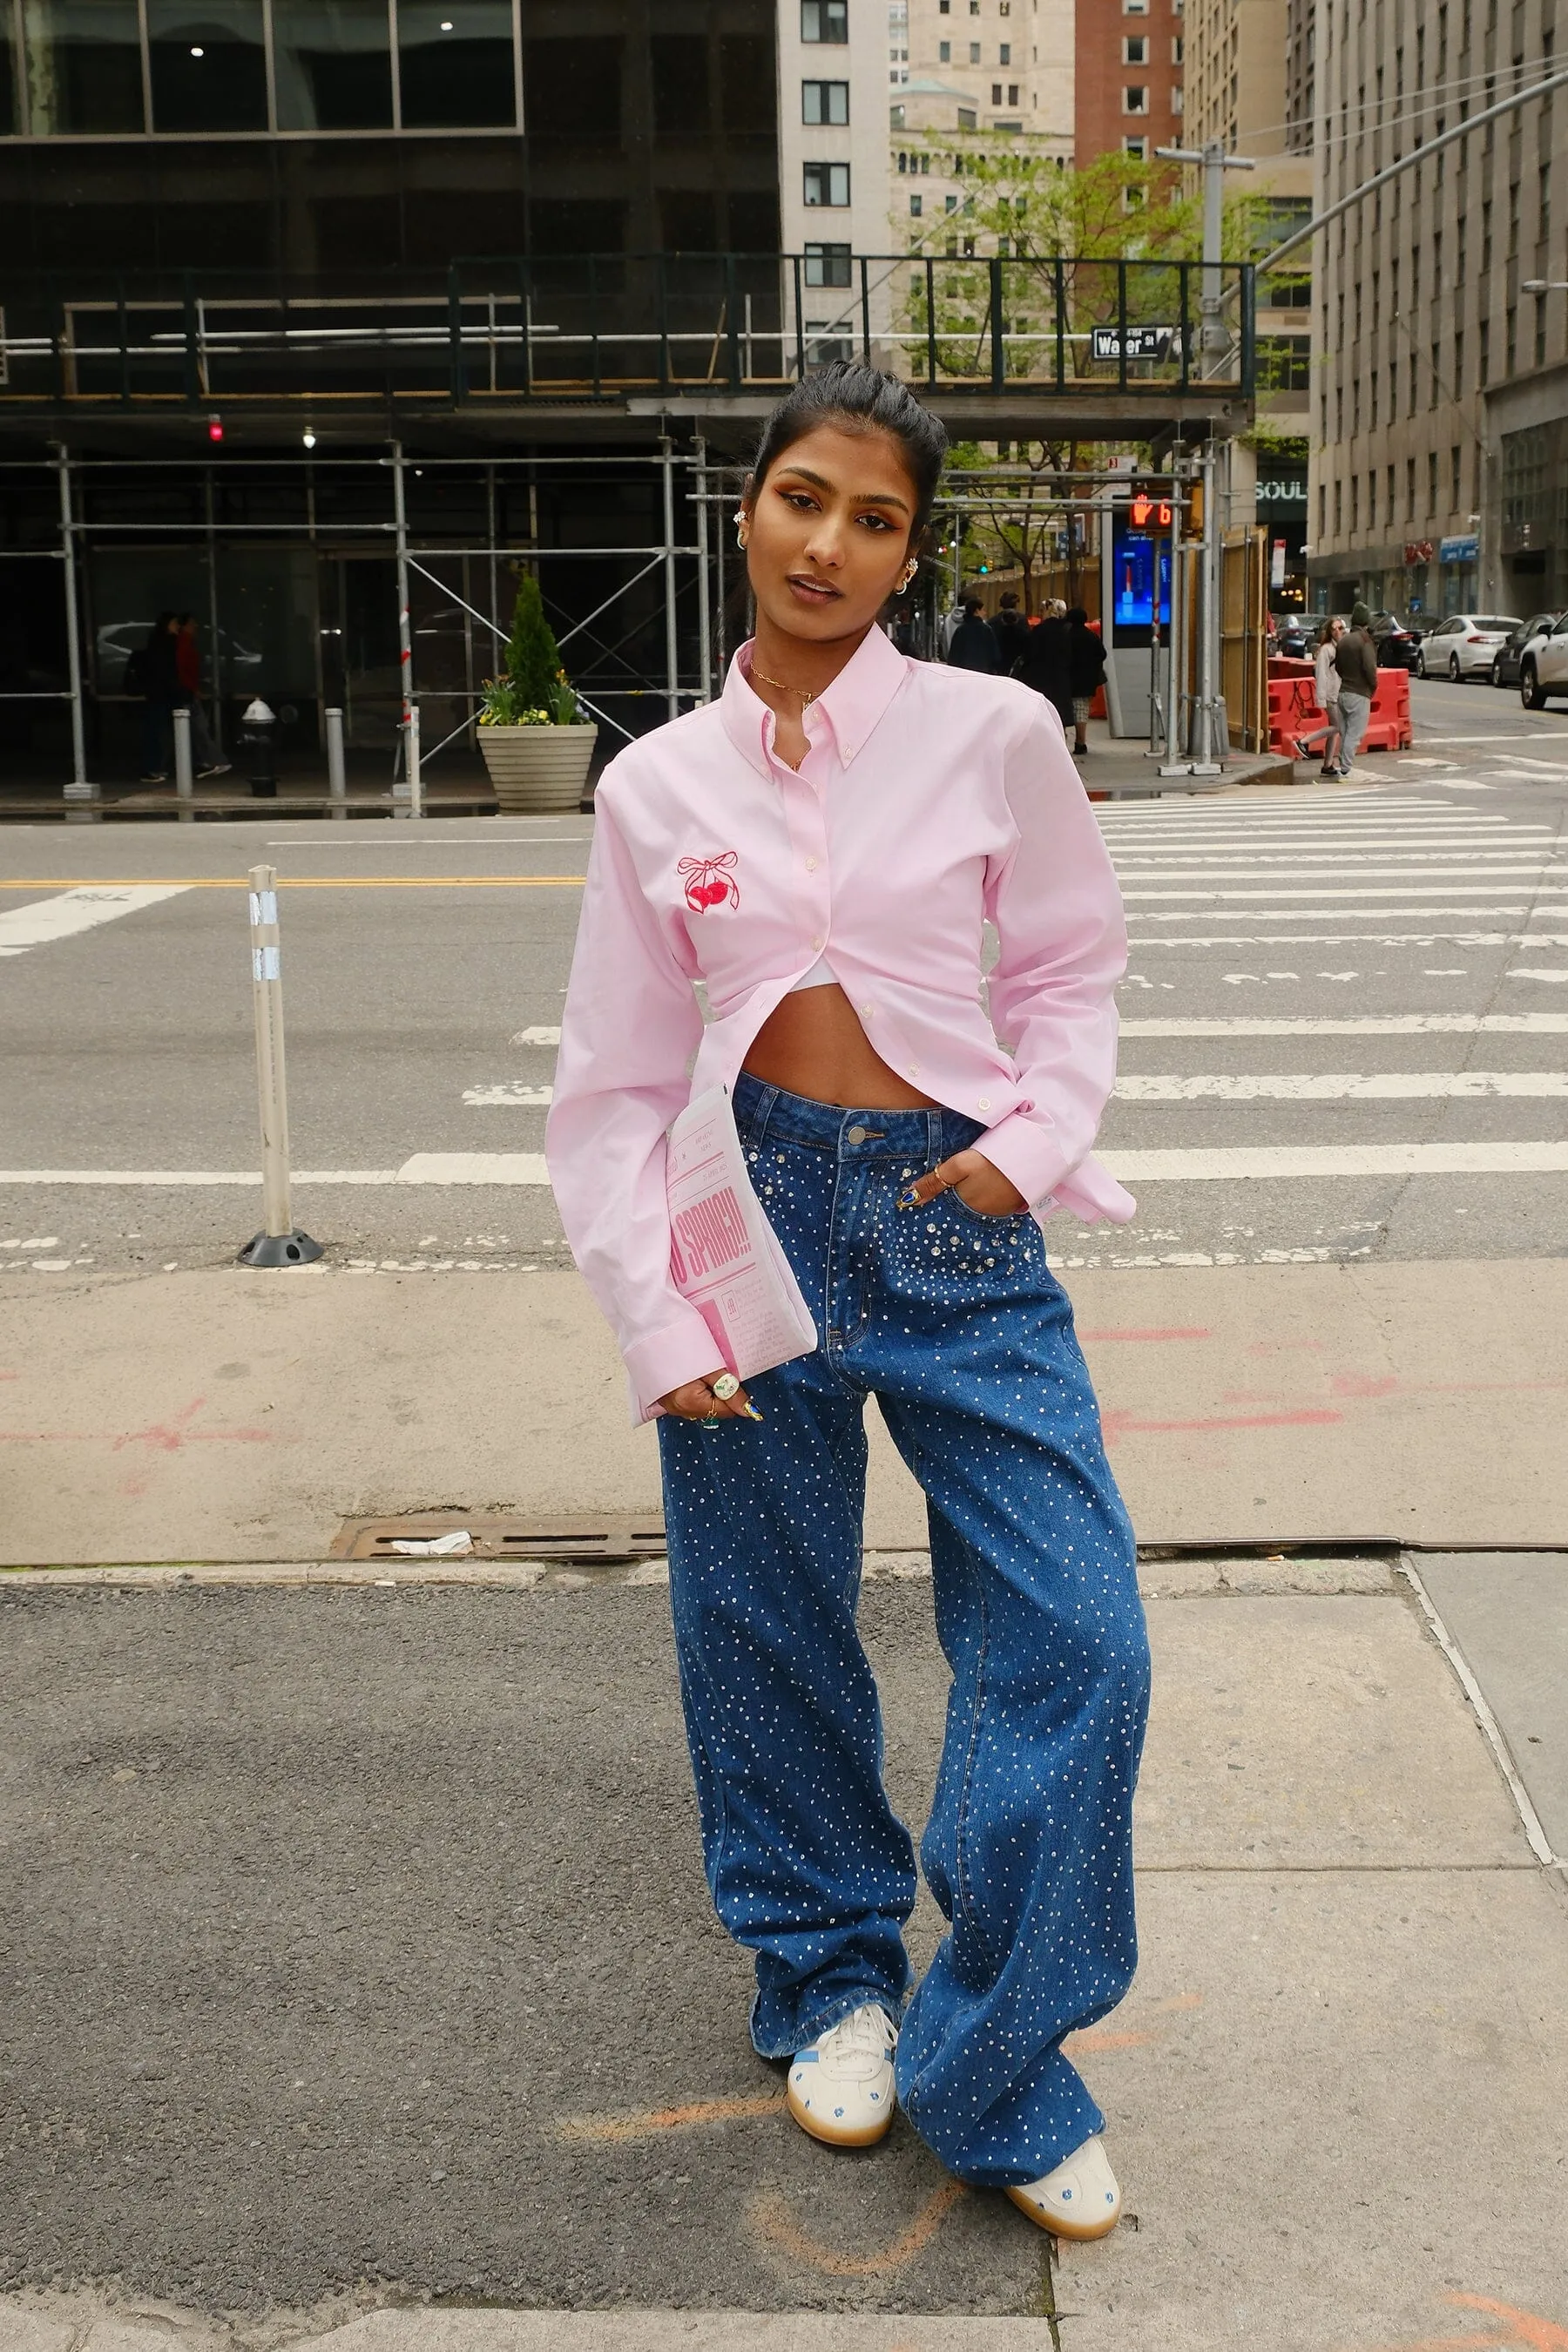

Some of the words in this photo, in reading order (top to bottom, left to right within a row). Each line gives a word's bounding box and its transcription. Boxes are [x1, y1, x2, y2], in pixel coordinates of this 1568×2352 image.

[1098, 336, 1141, 355] Waer
[1144, 335, 1154, 347] St
[1255, 481, 1308, 500] SOUL
